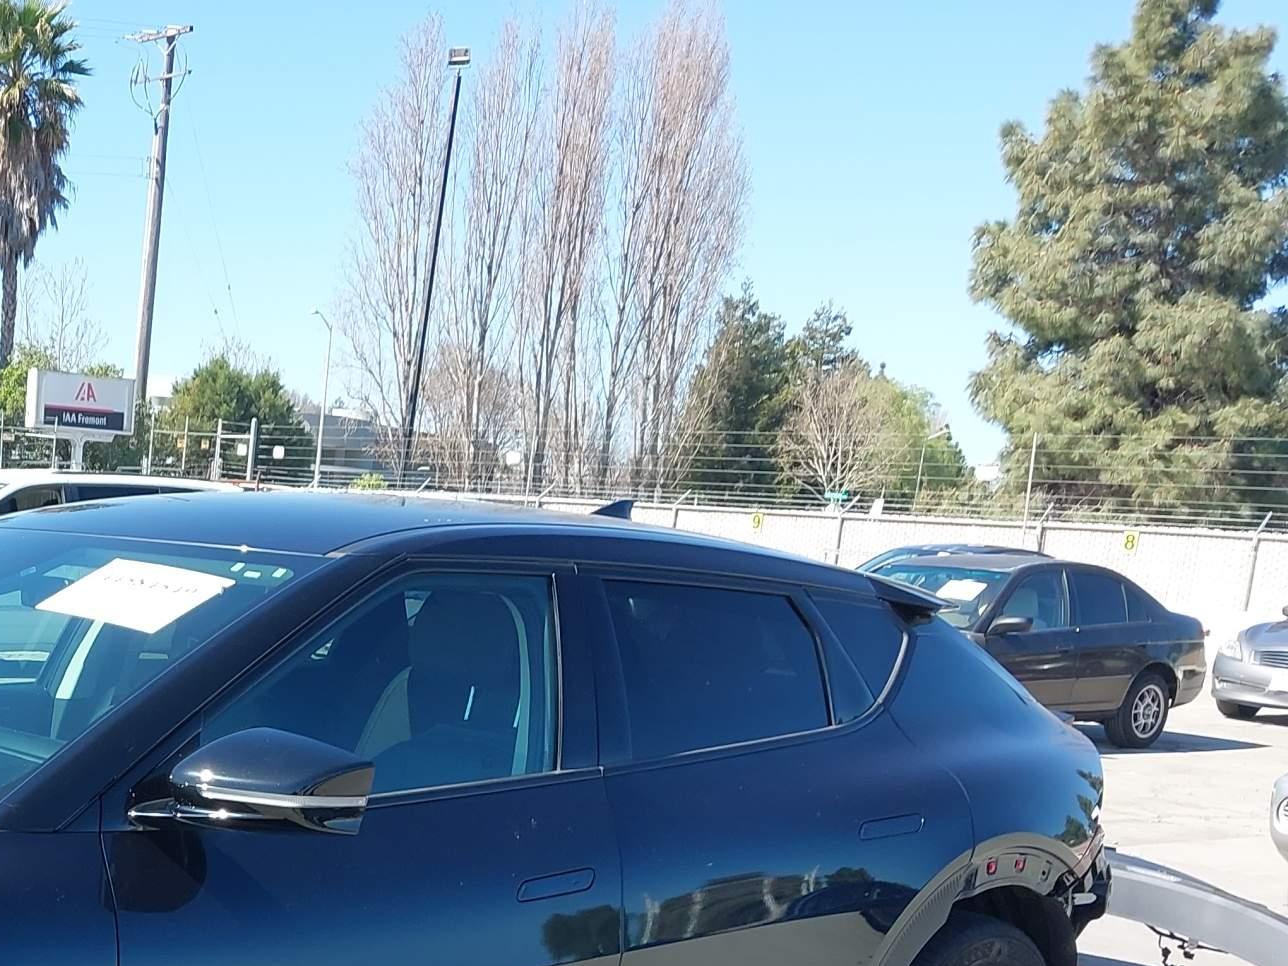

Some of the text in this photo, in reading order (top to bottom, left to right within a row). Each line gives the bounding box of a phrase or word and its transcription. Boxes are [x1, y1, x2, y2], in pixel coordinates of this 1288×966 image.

[62, 411, 107, 426] IAA Fremont
[752, 514, 761, 529] 9
[1124, 534, 1135, 550] 8
